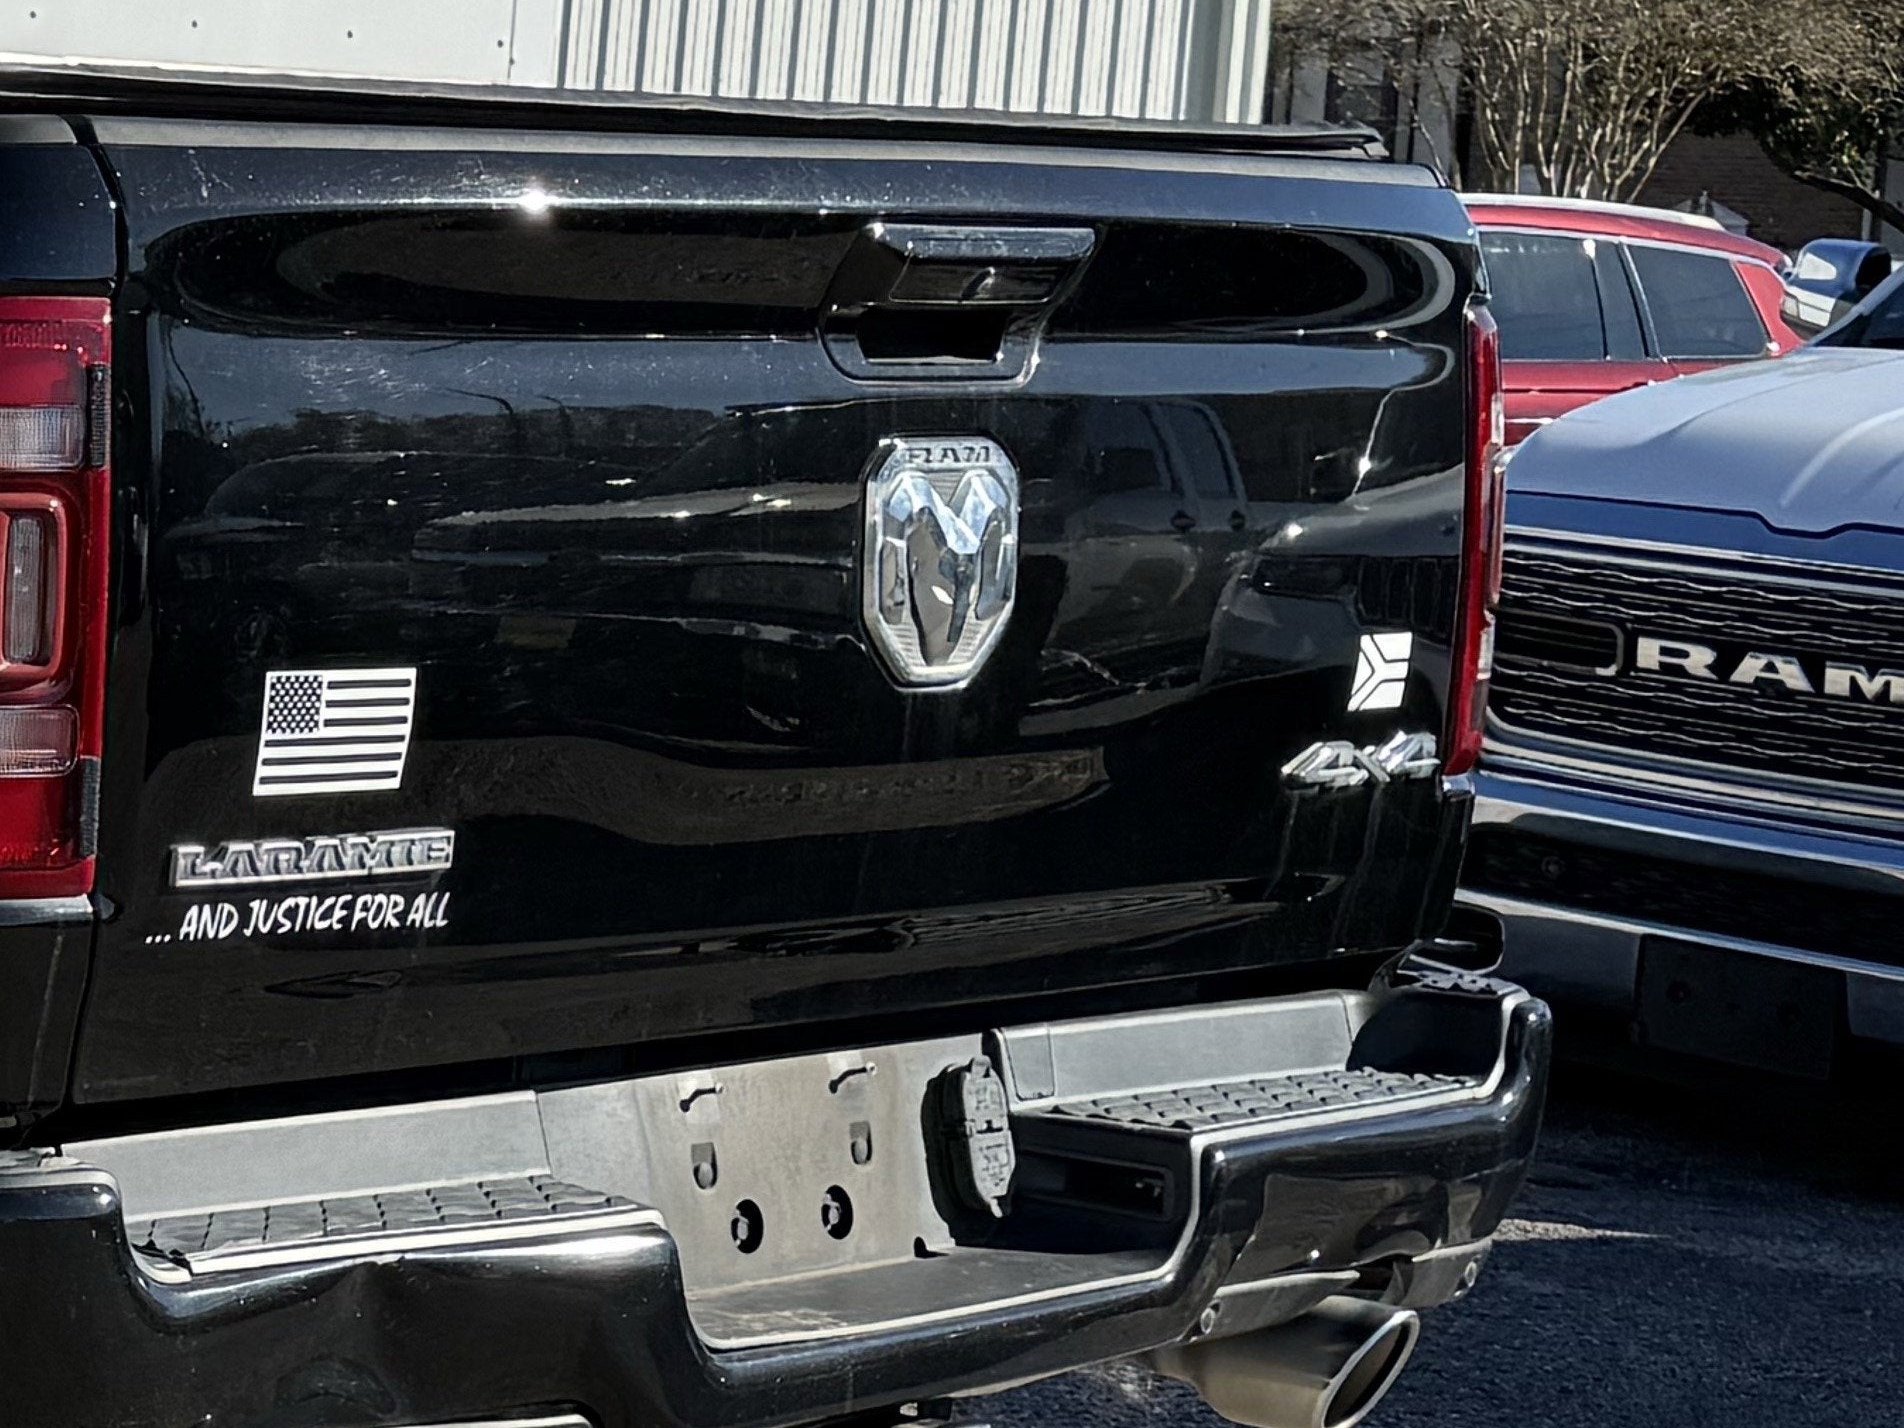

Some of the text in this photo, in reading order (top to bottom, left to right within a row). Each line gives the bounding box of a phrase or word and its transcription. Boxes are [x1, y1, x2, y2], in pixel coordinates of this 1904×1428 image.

[905, 445, 992, 464] RAM
[1636, 635, 1904, 704] RAM
[172, 829, 455, 886] LARAMIE
[179, 902, 239, 942] AND
[244, 893, 353, 938] JUSTICE
[351, 892, 404, 933] FOR
[406, 891, 451, 929] ALL
